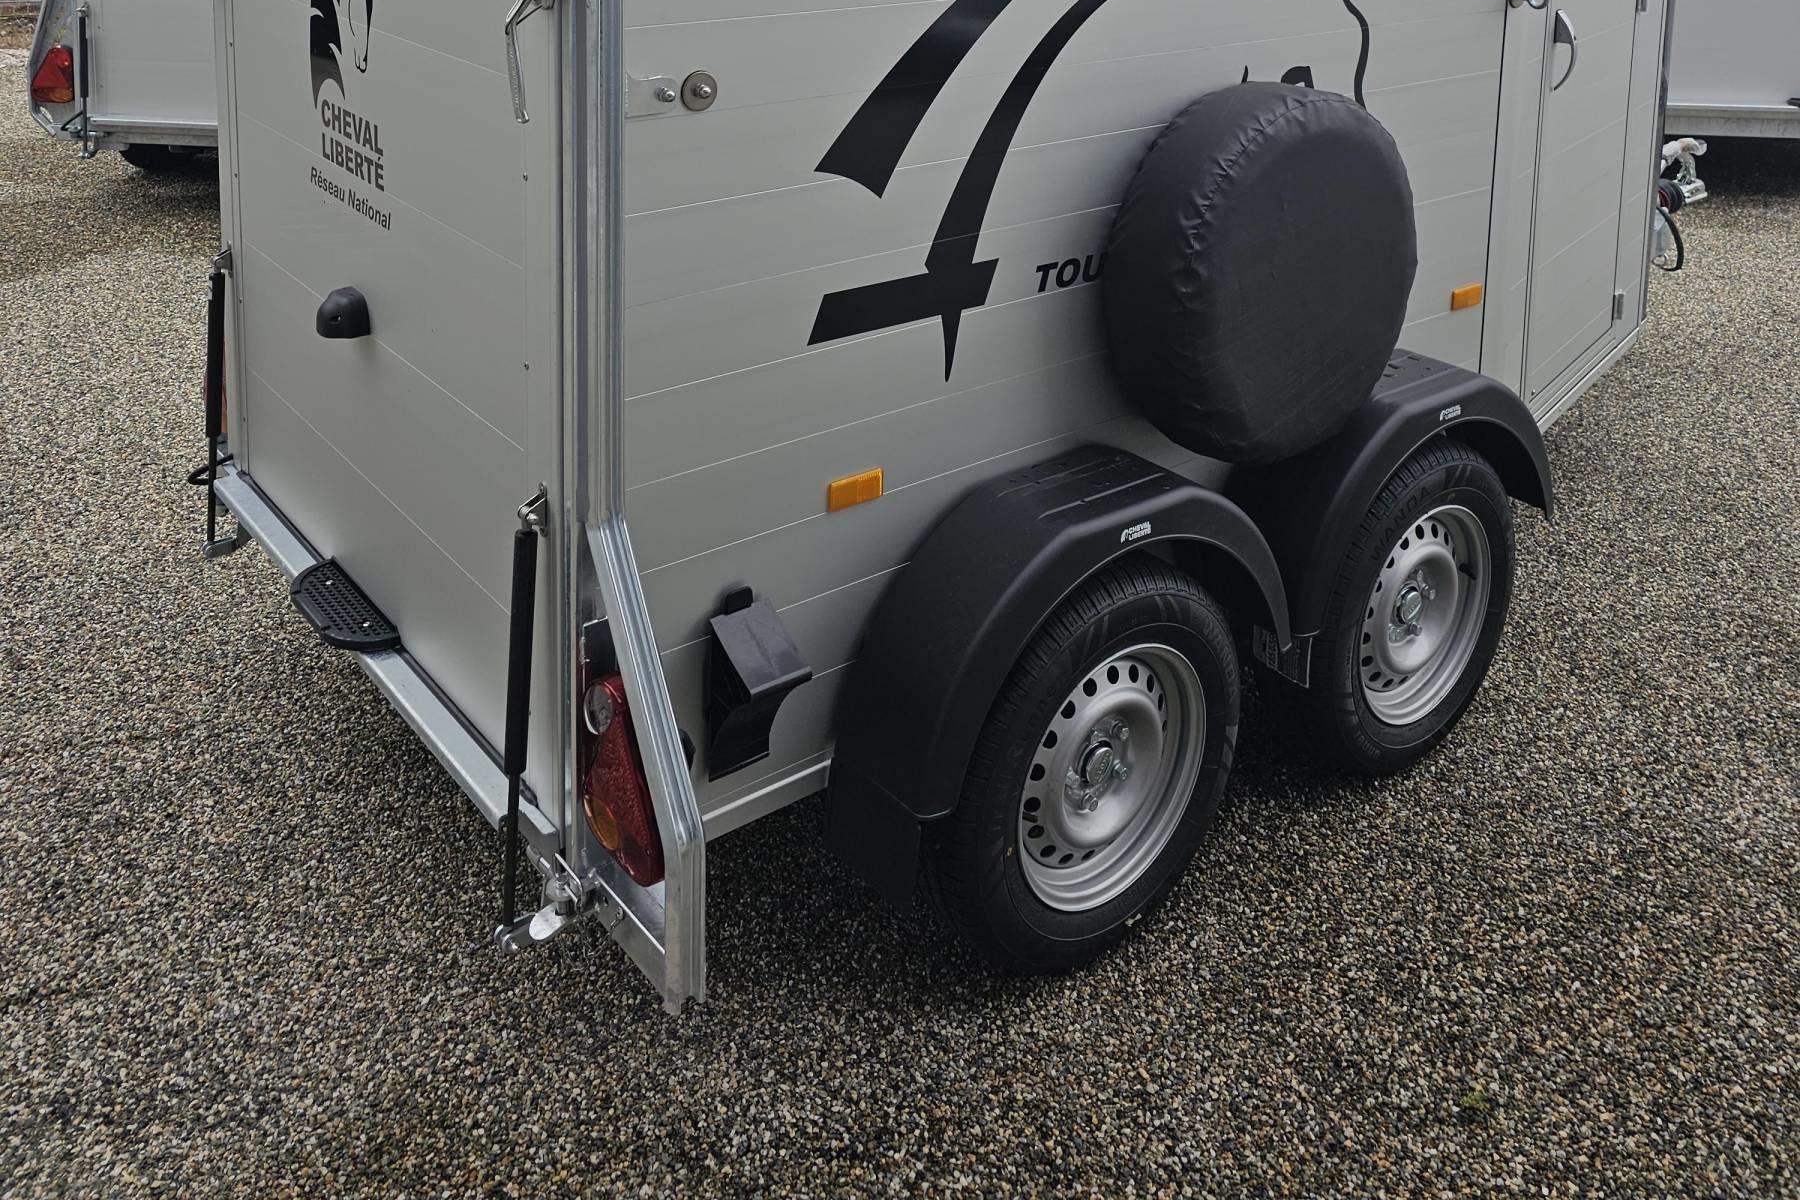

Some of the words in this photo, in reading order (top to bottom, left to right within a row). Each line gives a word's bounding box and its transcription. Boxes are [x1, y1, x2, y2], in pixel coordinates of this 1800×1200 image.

[321, 99, 384, 157] CHEVAL
[322, 132, 385, 192] LIBERTÉ
[310, 166, 345, 203] Réseau
[348, 188, 391, 231] National
